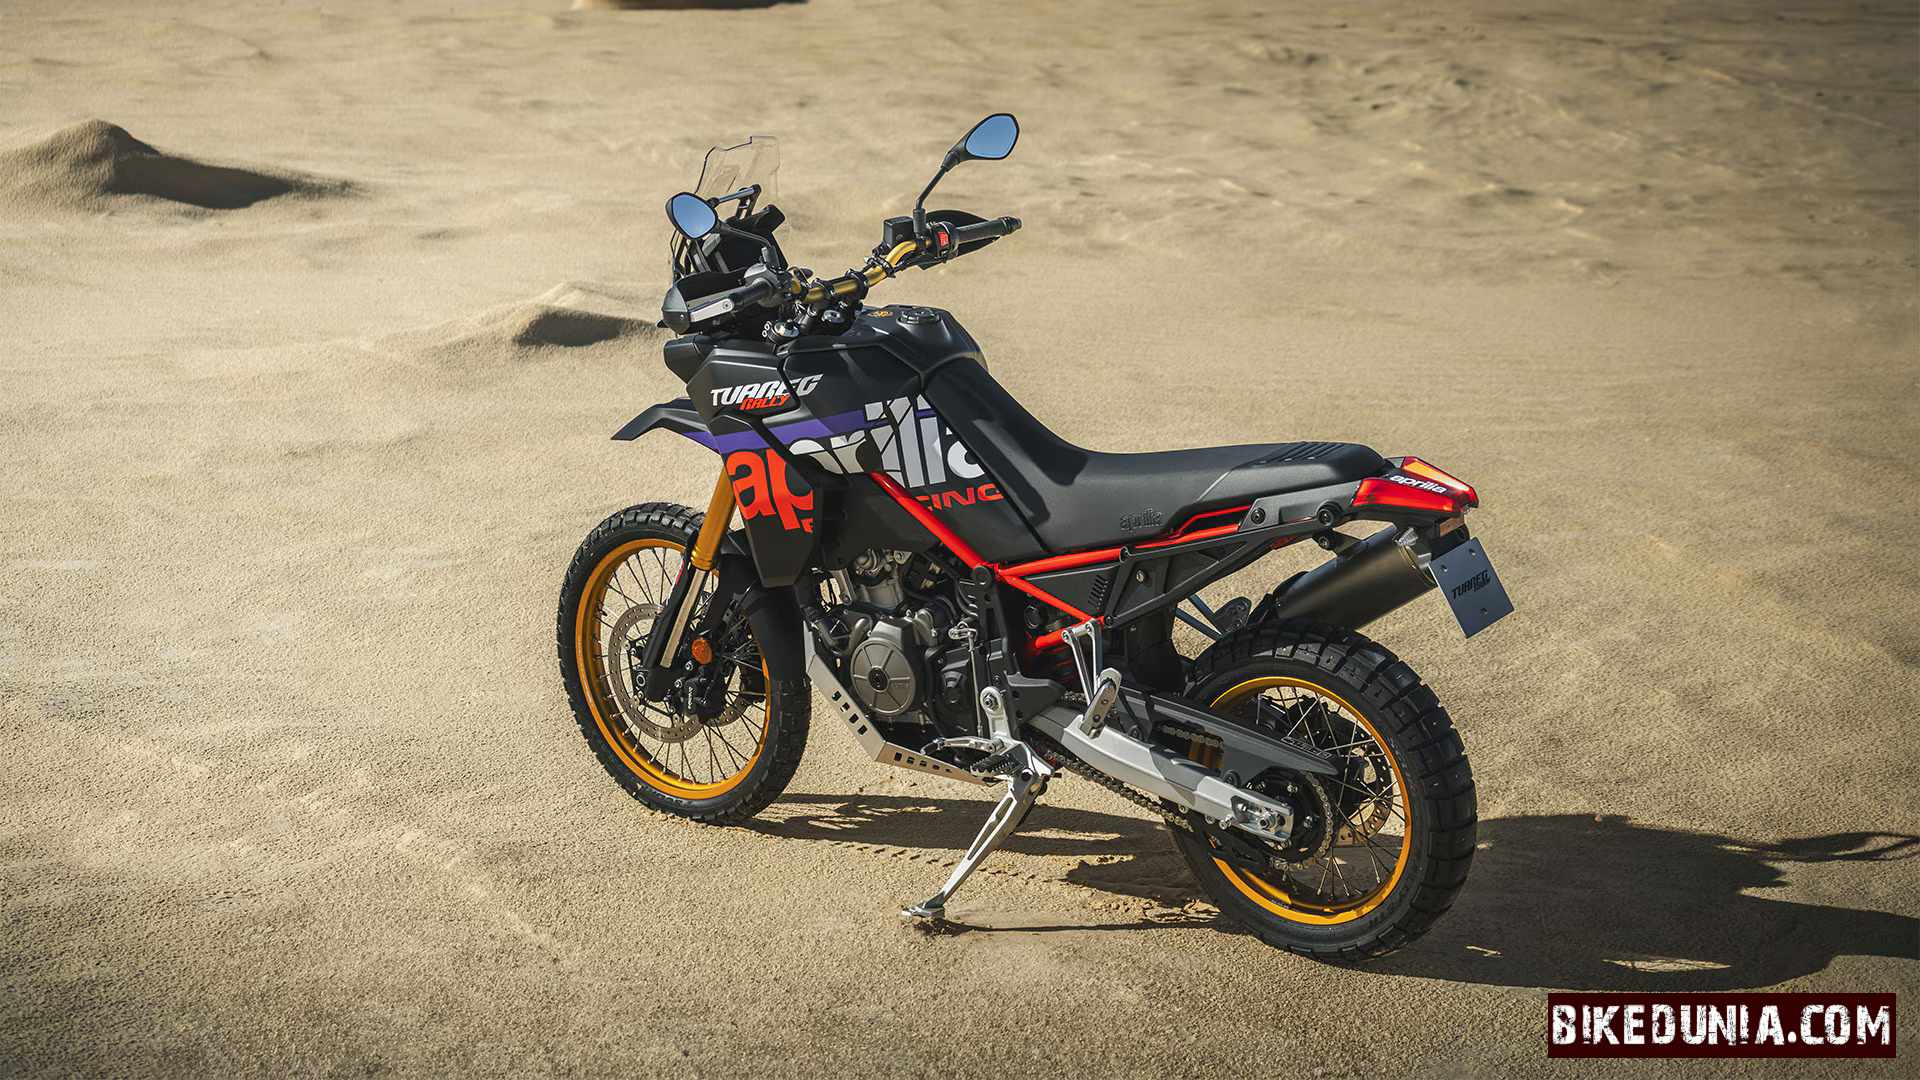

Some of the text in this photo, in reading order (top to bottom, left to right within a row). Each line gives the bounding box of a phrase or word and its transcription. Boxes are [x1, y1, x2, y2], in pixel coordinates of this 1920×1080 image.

[710, 373, 824, 406] TUAREG
[739, 394, 791, 411] RALLY
[1389, 474, 1448, 494] aprilia
[1451, 569, 1491, 601] TUAREG
